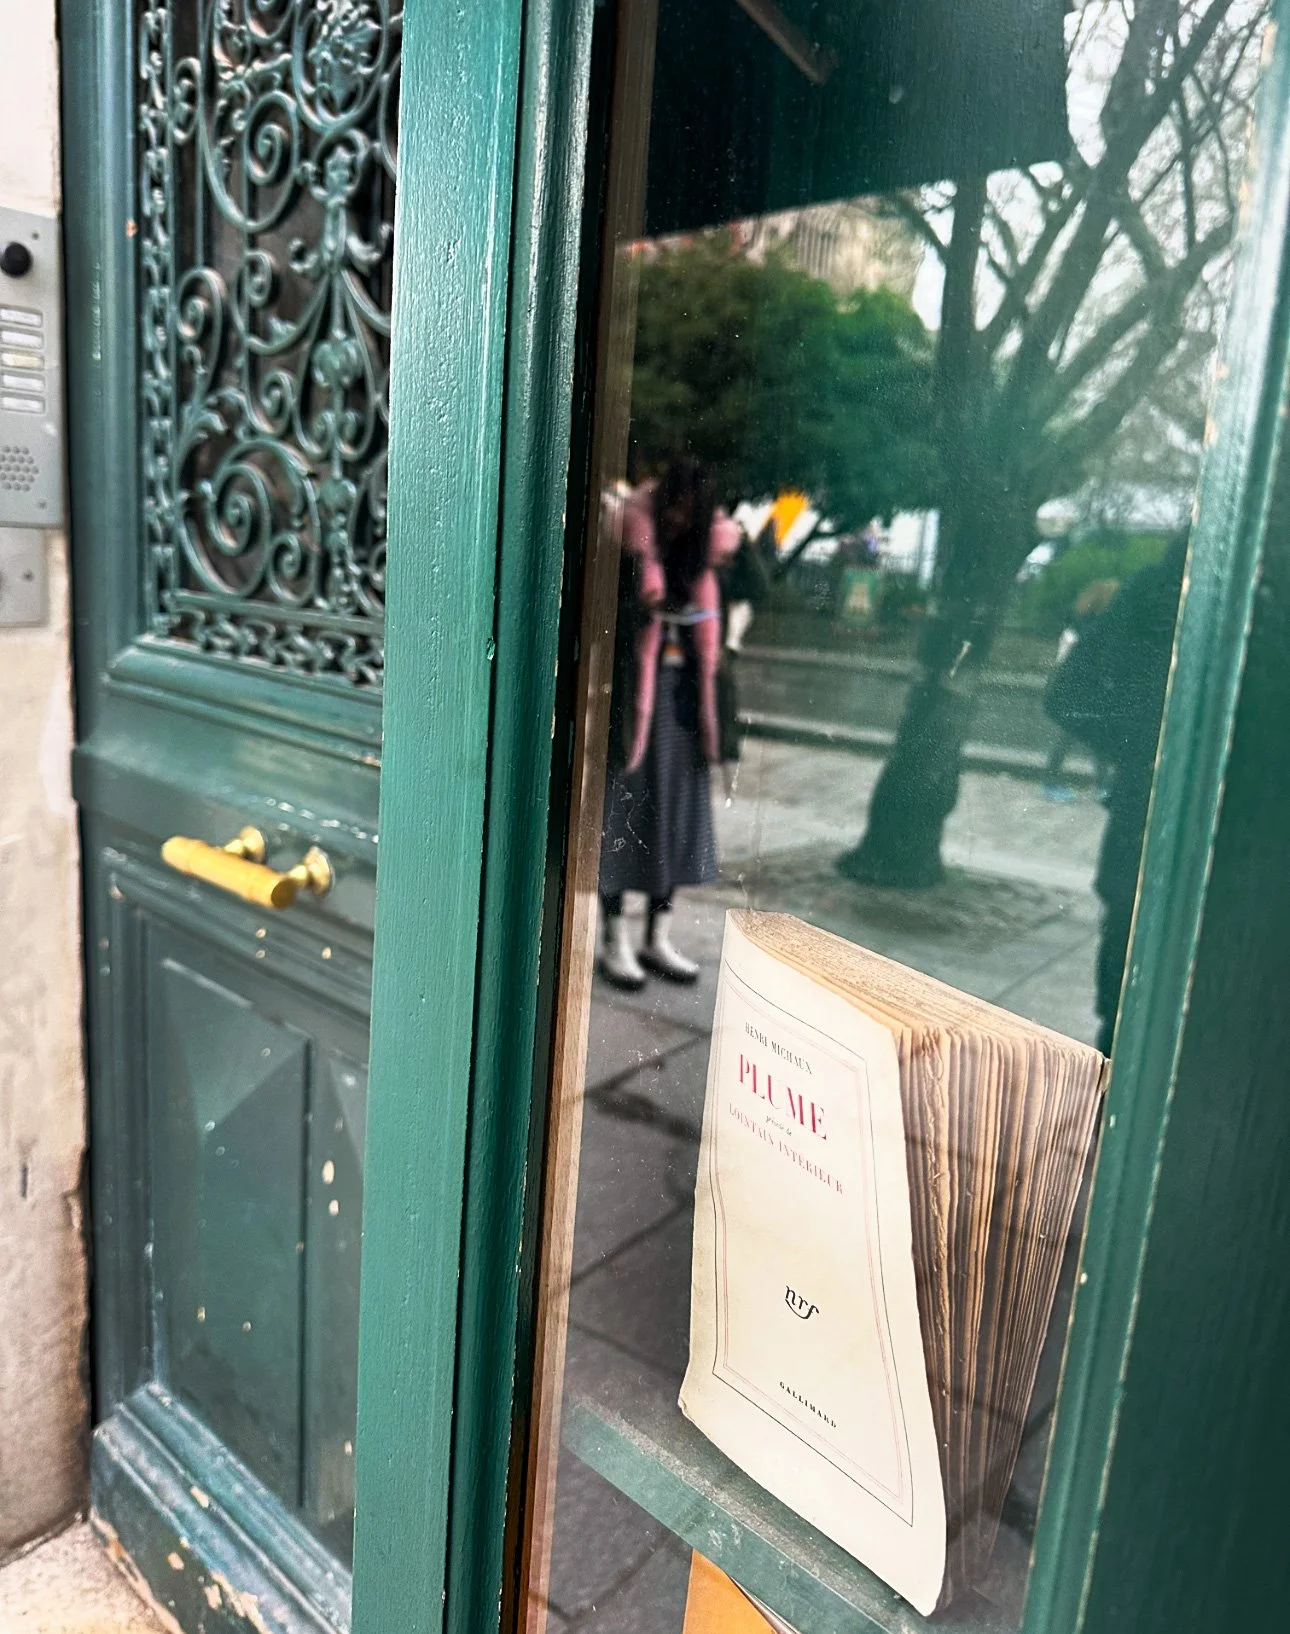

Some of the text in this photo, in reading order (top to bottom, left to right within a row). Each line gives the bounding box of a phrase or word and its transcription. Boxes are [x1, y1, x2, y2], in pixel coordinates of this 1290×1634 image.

[745, 1021, 812, 1075] HENRI MICHAUX
[739, 1054, 827, 1140] PLUME
[785, 1285, 819, 1319] nrf
[779, 1381, 837, 1428] GALLIMARD
